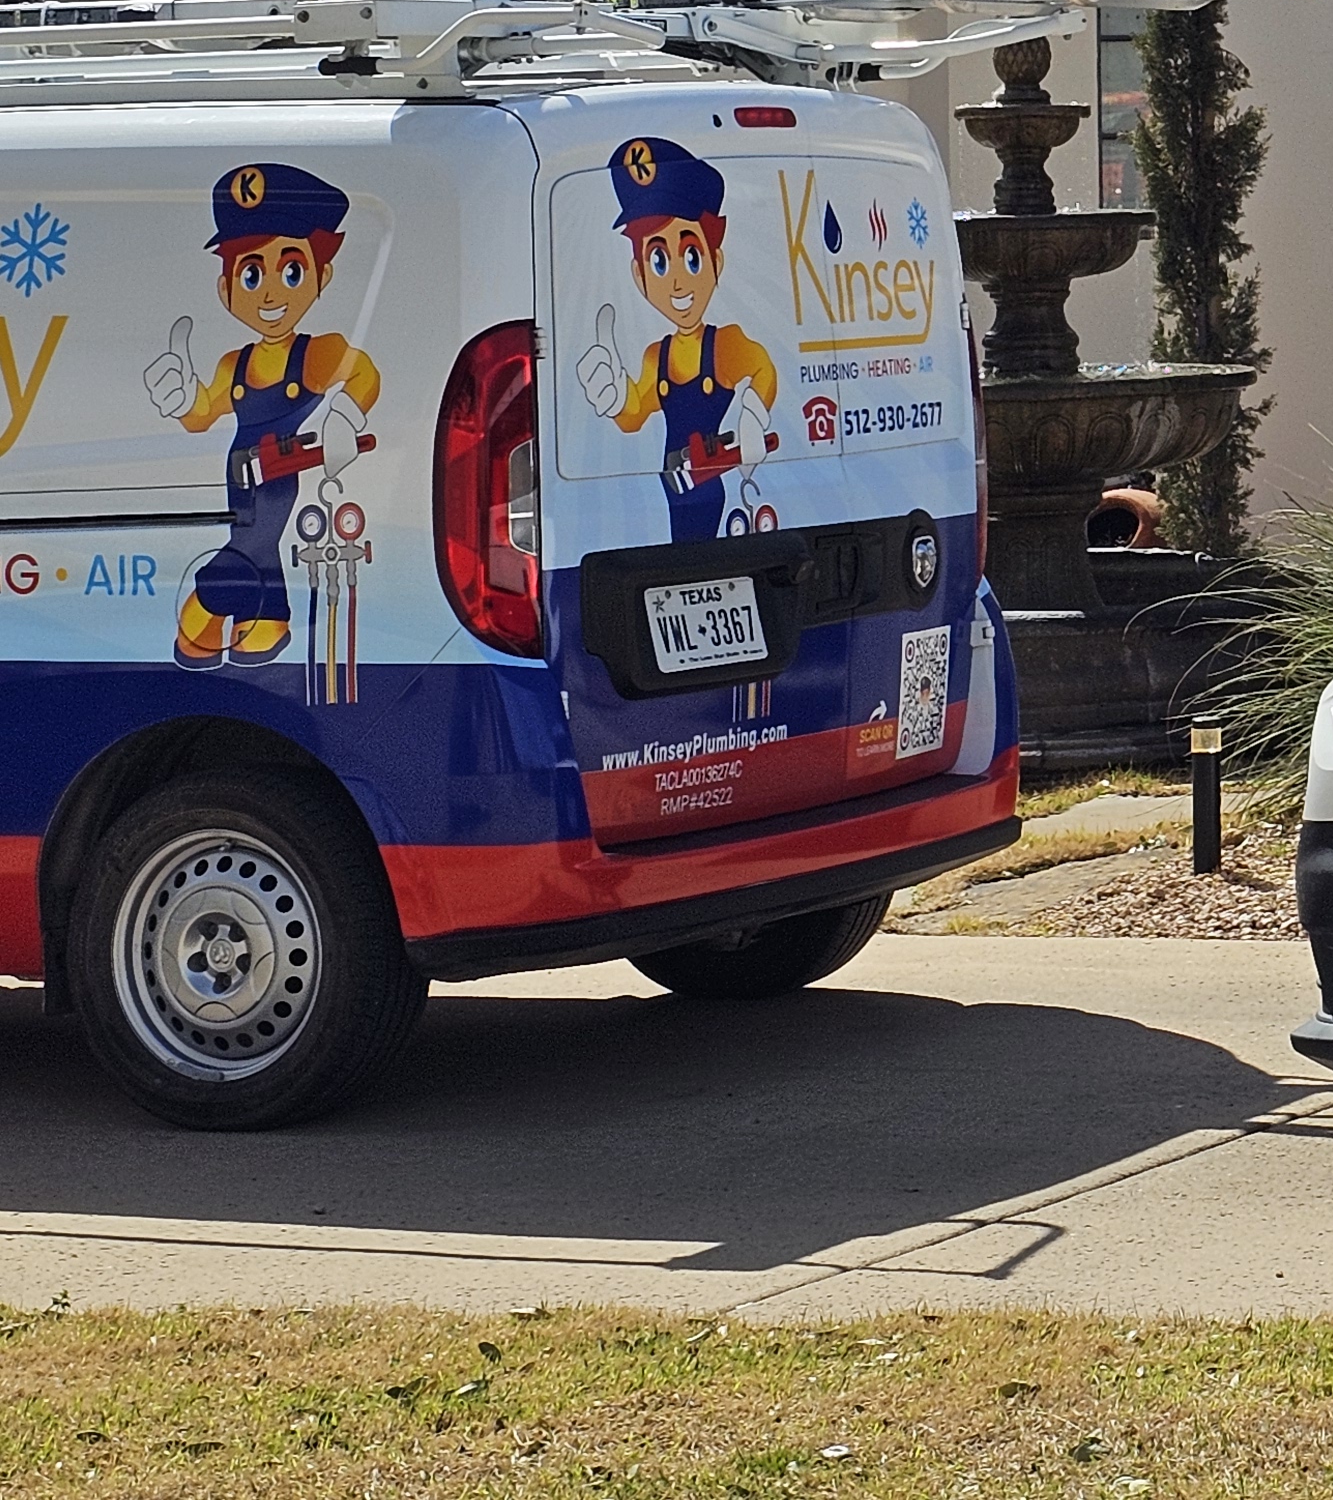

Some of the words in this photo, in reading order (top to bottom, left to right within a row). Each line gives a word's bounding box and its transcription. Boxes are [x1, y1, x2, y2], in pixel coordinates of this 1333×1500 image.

[631, 146, 651, 180] K
[239, 172, 258, 203] K
[778, 169, 935, 353] Kinsey
[800, 362, 859, 384] PLUMBING
[867, 358, 911, 378] HEATING
[918, 356, 934, 373] AIR
[844, 401, 943, 436] 512-930-2677
[84, 554, 157, 596] AIR
[679, 586, 722, 606] TEXAS
[705, 605, 755, 647] 3367
[602, 723, 788, 772] www.KinseyPlumbing.com
[655, 760, 743, 792] TACLA00136274C
[661, 787, 733, 816] RMP#42522
